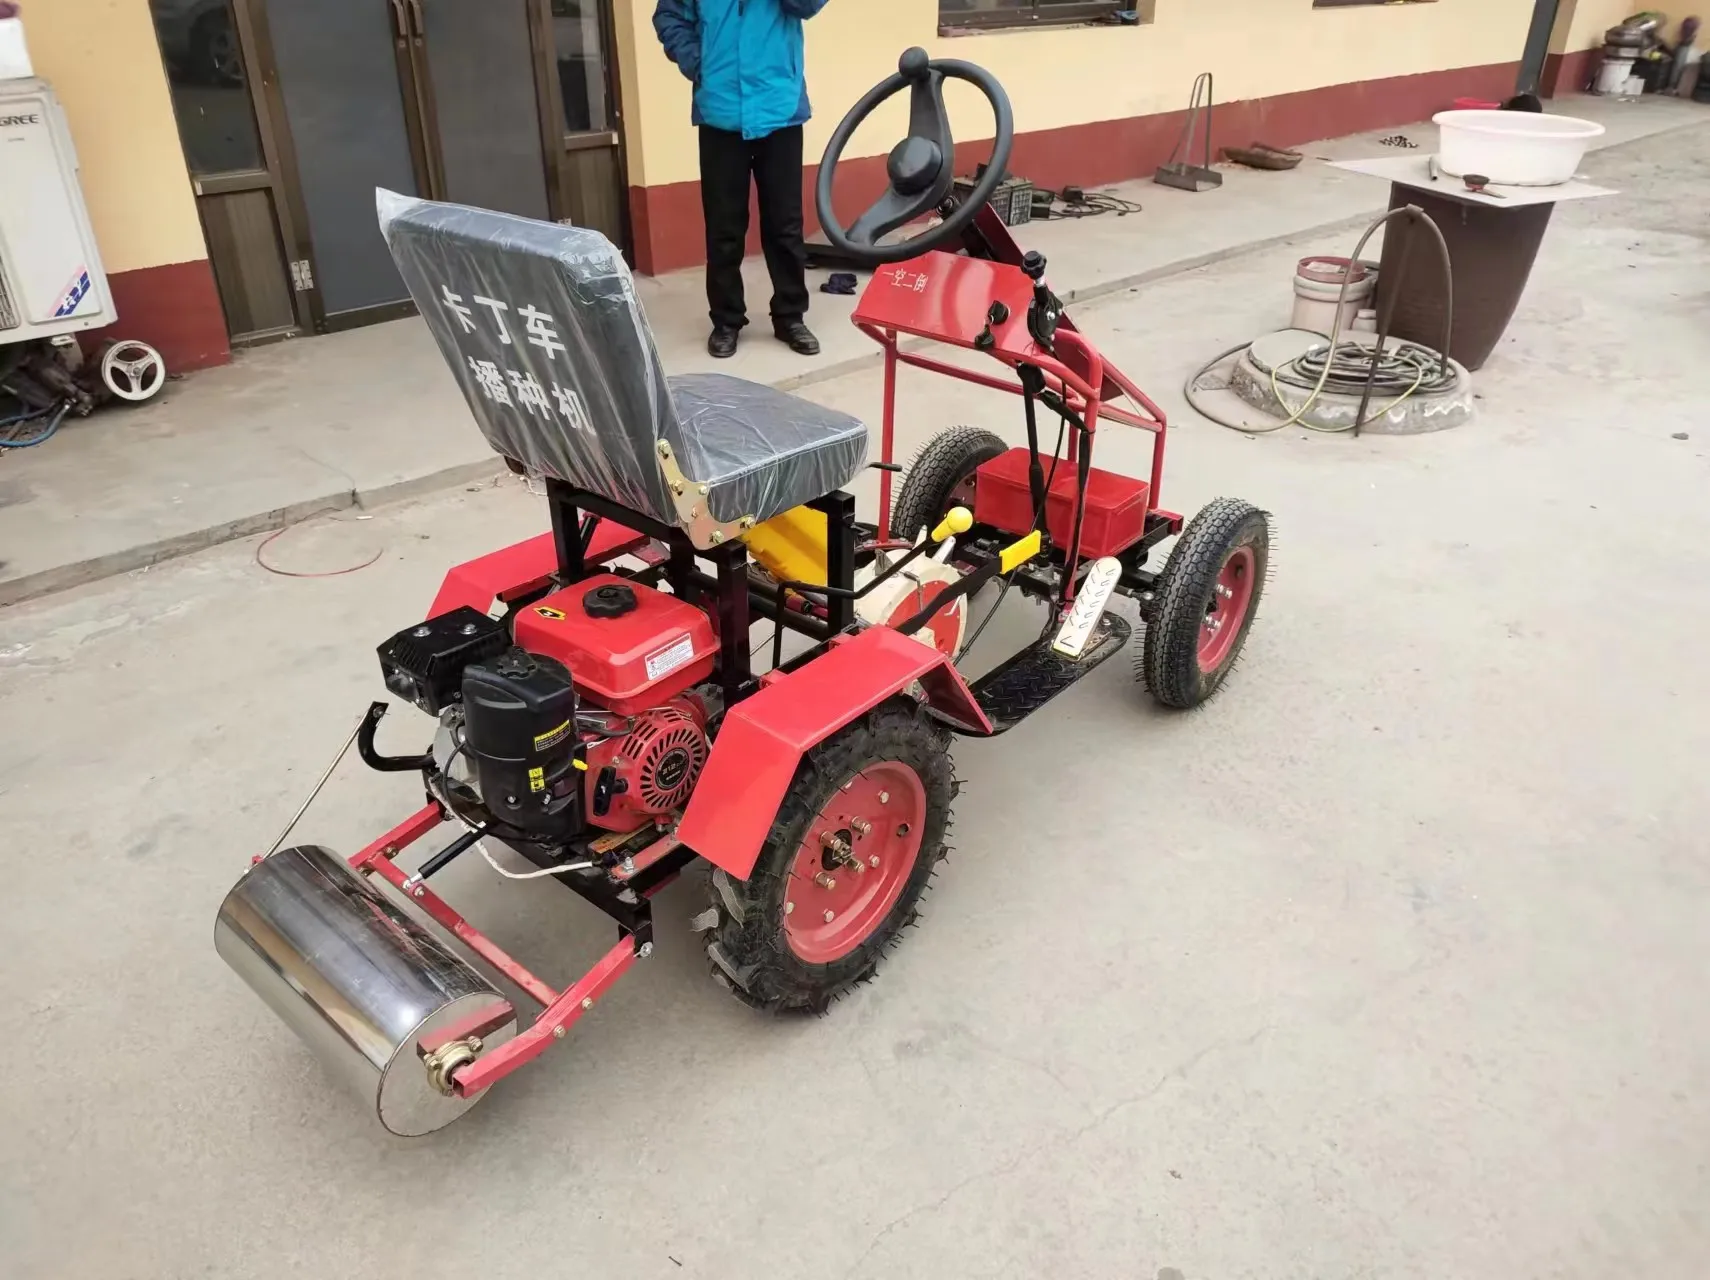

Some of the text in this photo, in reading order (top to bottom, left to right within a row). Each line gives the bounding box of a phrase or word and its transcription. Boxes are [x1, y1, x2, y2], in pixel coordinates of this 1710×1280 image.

[882, 268, 929, 293] 一空二倒
[441, 284, 566, 360] 卡丁车
[467, 355, 598, 436] 播种机
